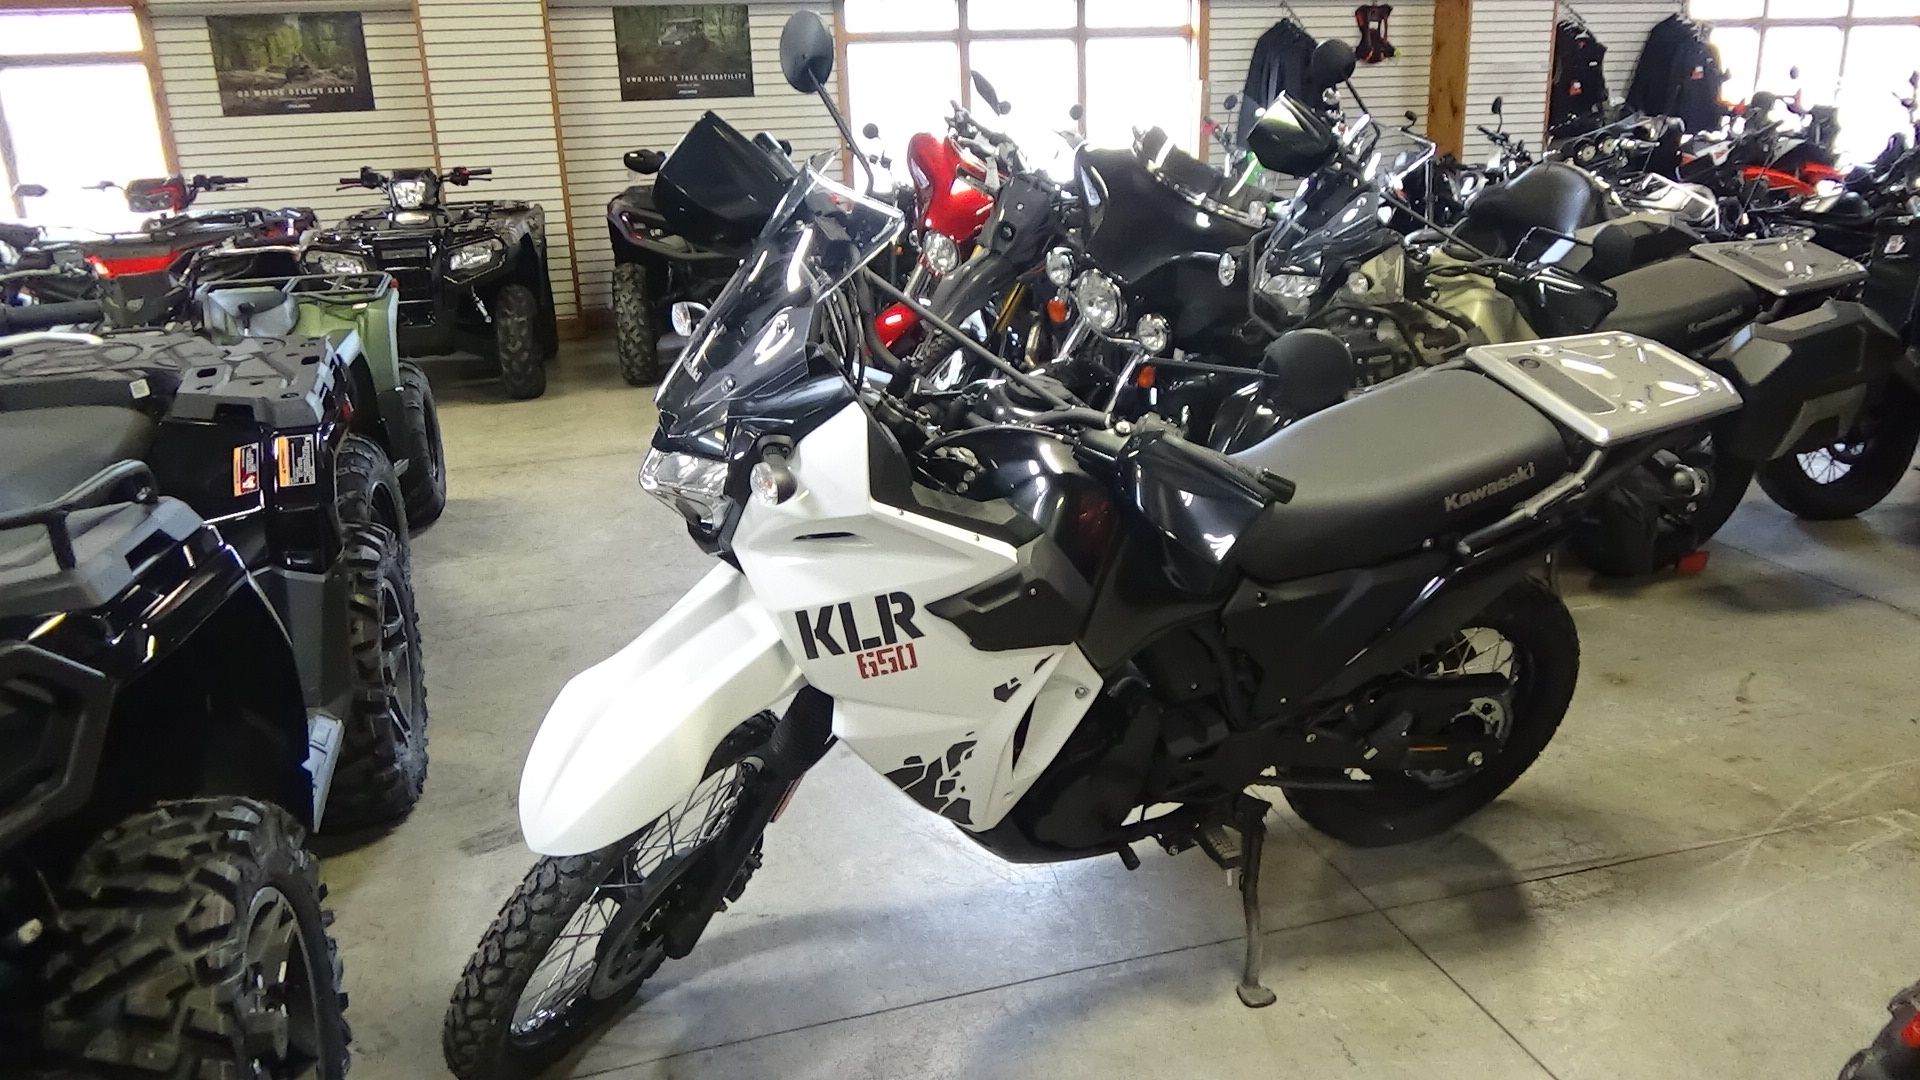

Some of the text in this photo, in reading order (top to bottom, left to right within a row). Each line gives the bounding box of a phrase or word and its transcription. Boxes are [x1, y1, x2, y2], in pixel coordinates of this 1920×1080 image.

[1444, 461, 1536, 513] Kawasaki
[795, 591, 925, 660] KLR
[856, 643, 918, 679] 650
